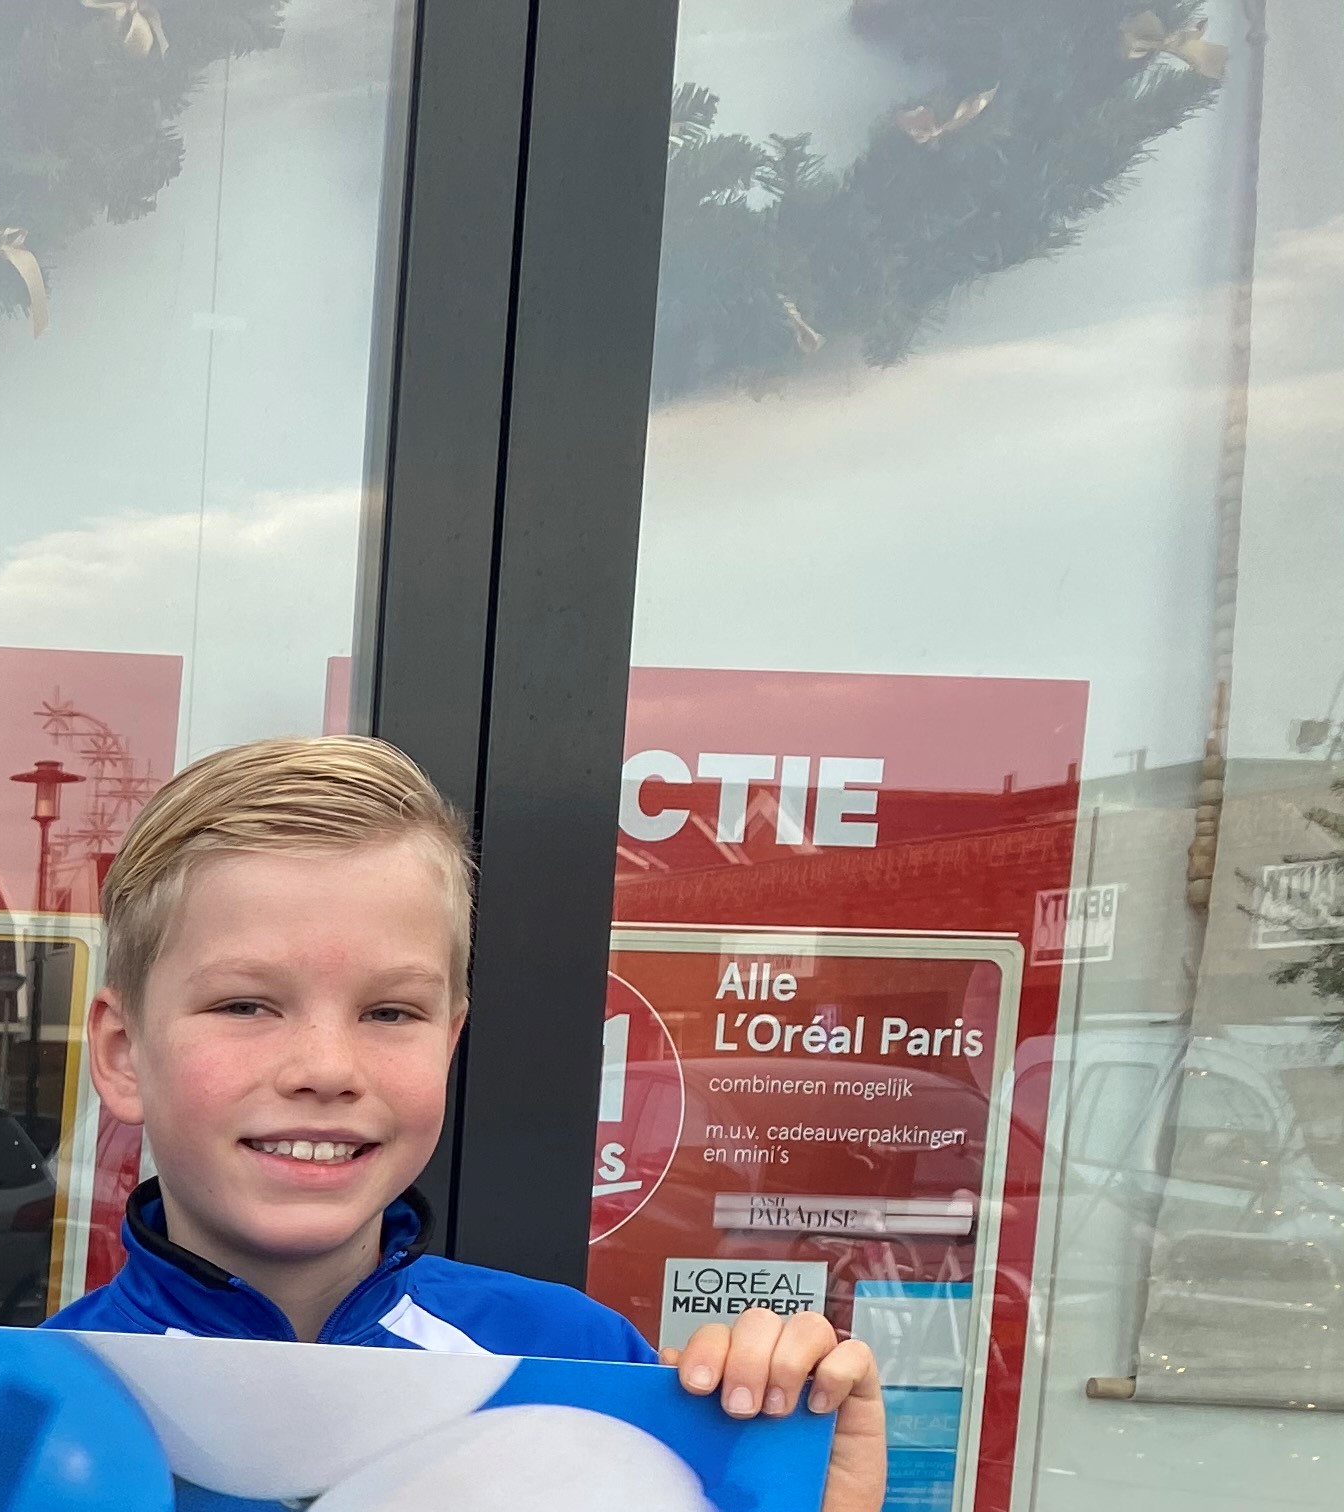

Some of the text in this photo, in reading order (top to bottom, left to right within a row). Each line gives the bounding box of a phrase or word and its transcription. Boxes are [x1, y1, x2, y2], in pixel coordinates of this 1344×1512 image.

[617, 749, 885, 848] CTIE
[715, 962, 798, 1001] Alle
[880, 1017, 983, 1058] Paris
[709, 1075, 913, 1101] combineren mogelijk
[705, 1123, 966, 1149] m.u.v. cadeauverpakkingen
[703, 1146, 727, 1162] en
[749, 1205, 859, 1229] PARADISE
[672, 1295, 814, 1315] MEN EXPERT
